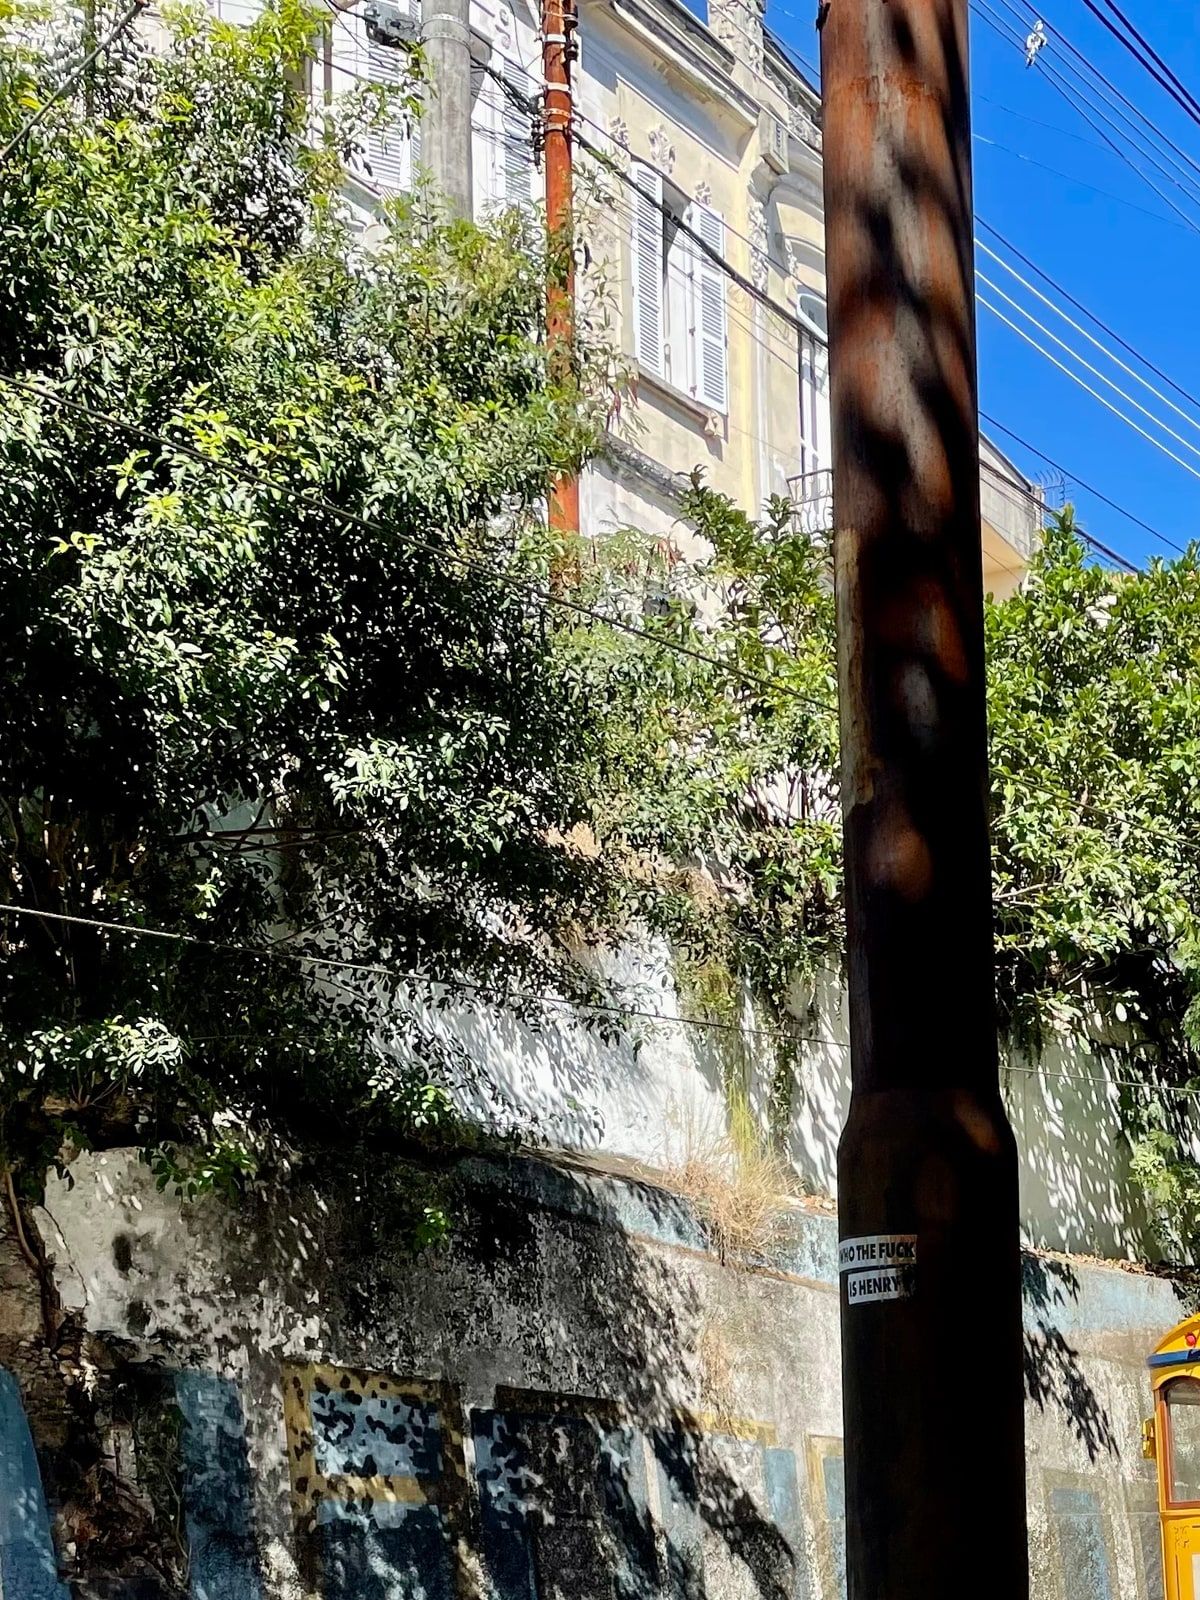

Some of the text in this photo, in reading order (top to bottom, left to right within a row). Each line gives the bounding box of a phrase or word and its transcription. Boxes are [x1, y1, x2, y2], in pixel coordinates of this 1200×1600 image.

[856, 1243, 876, 1261] THE
[878, 1241, 915, 1259] FUCK
[849, 1276, 898, 1298] IS HENRY
